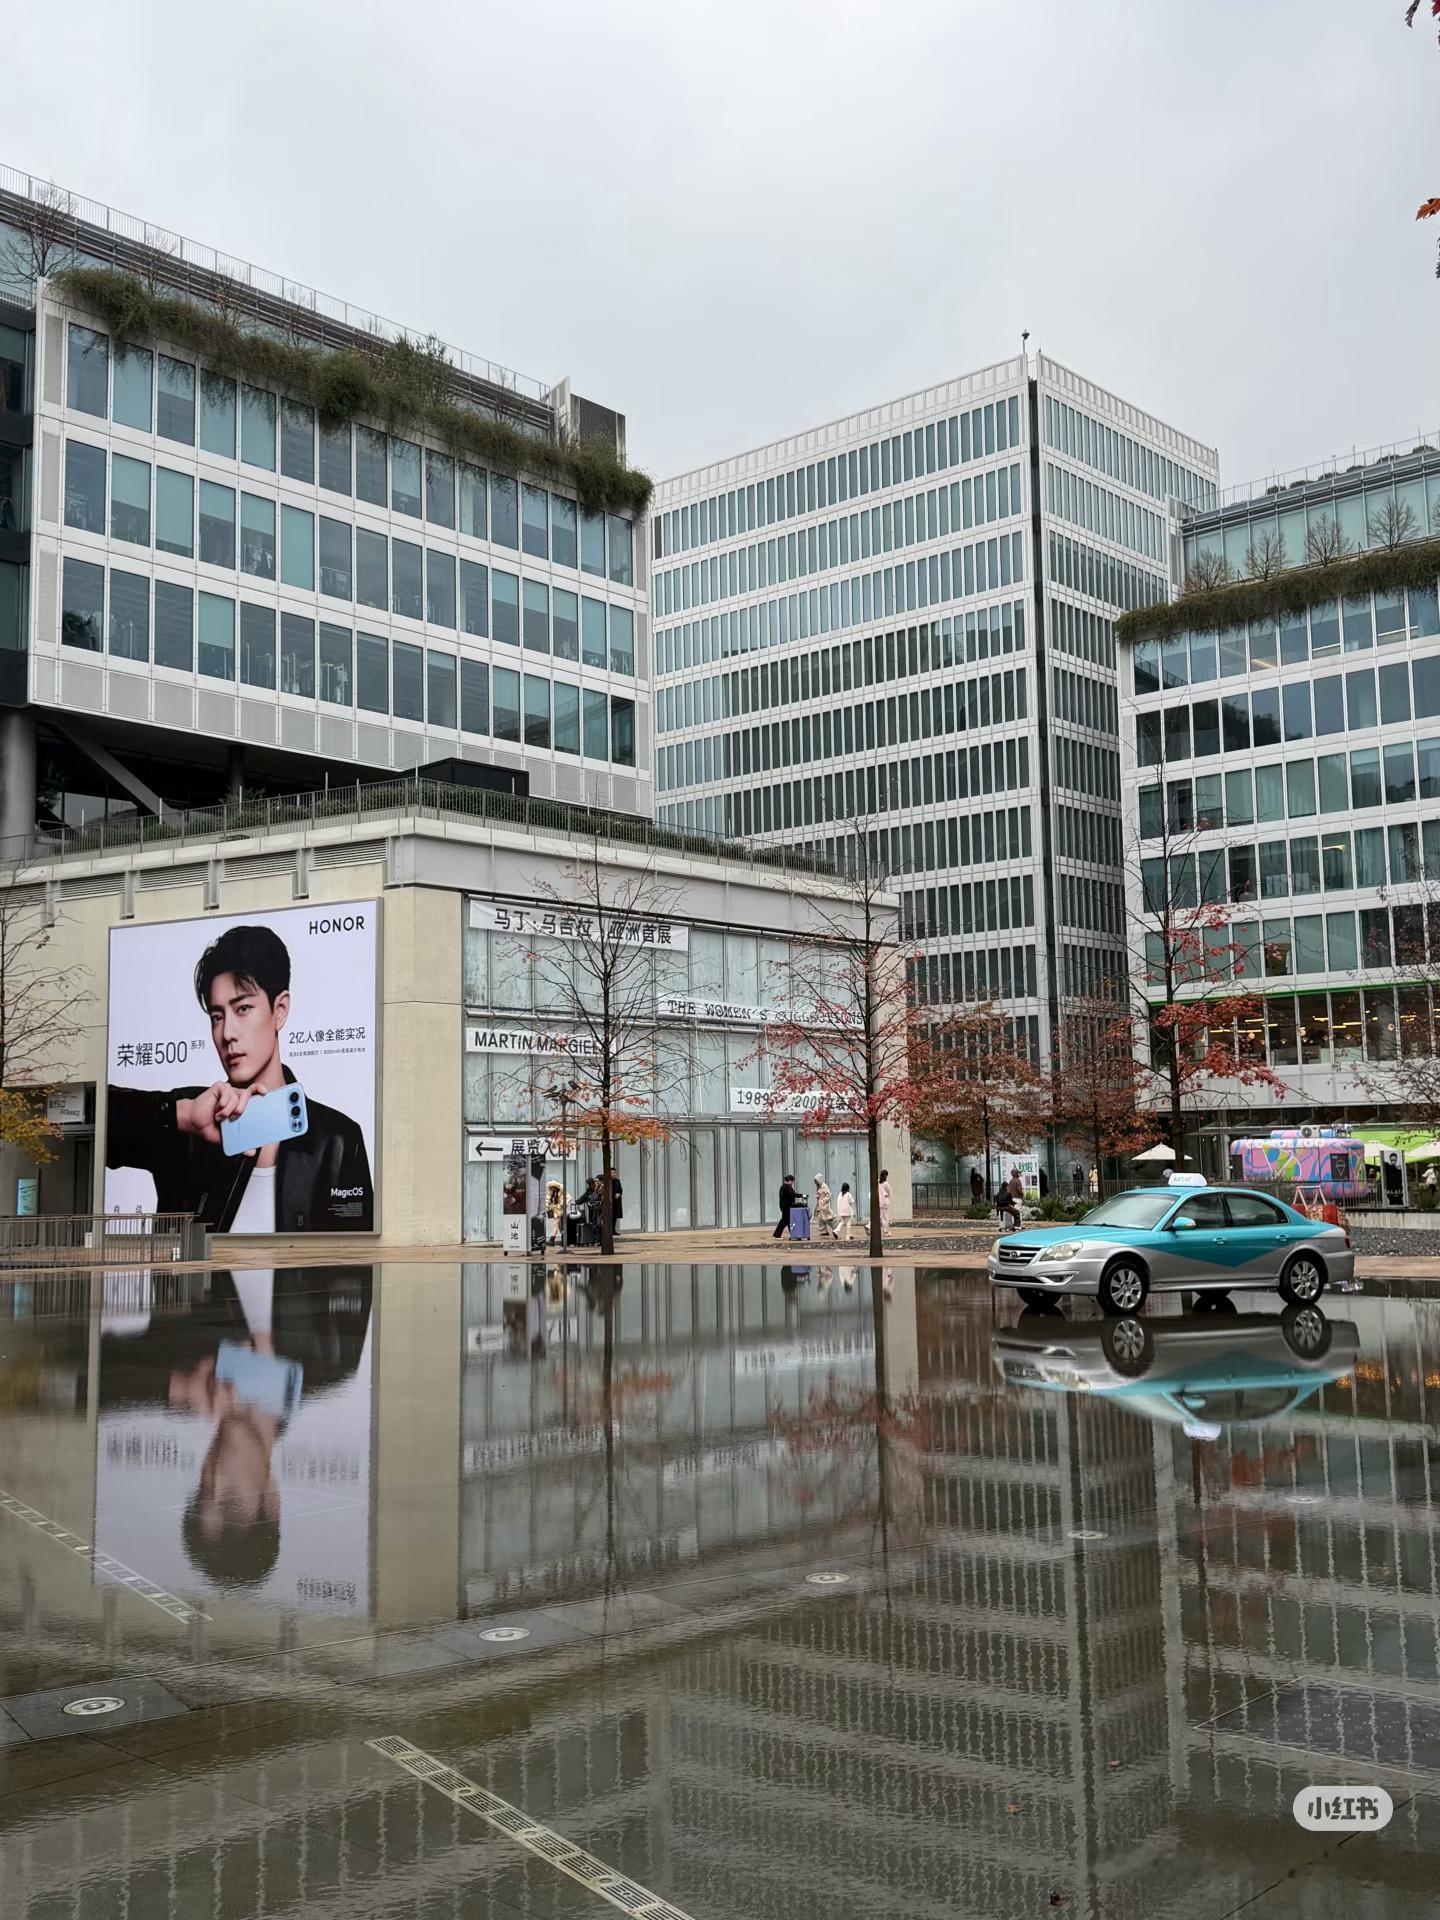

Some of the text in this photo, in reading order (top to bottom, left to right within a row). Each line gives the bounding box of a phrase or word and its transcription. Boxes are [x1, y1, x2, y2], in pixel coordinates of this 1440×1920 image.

[309, 915, 365, 935] HONOR
[608, 920, 672, 944] 亚洲首展
[667, 1000, 696, 1015] THE
[289, 1026, 365, 1044] 2亿人像全能实况
[475, 1031, 606, 1055] MARTIN MAGIEL
[117, 1039, 205, 1067] 荣耀500 系列
[737, 1091, 770, 1105] 1989
[330, 1186, 364, 1198] MagicOS
